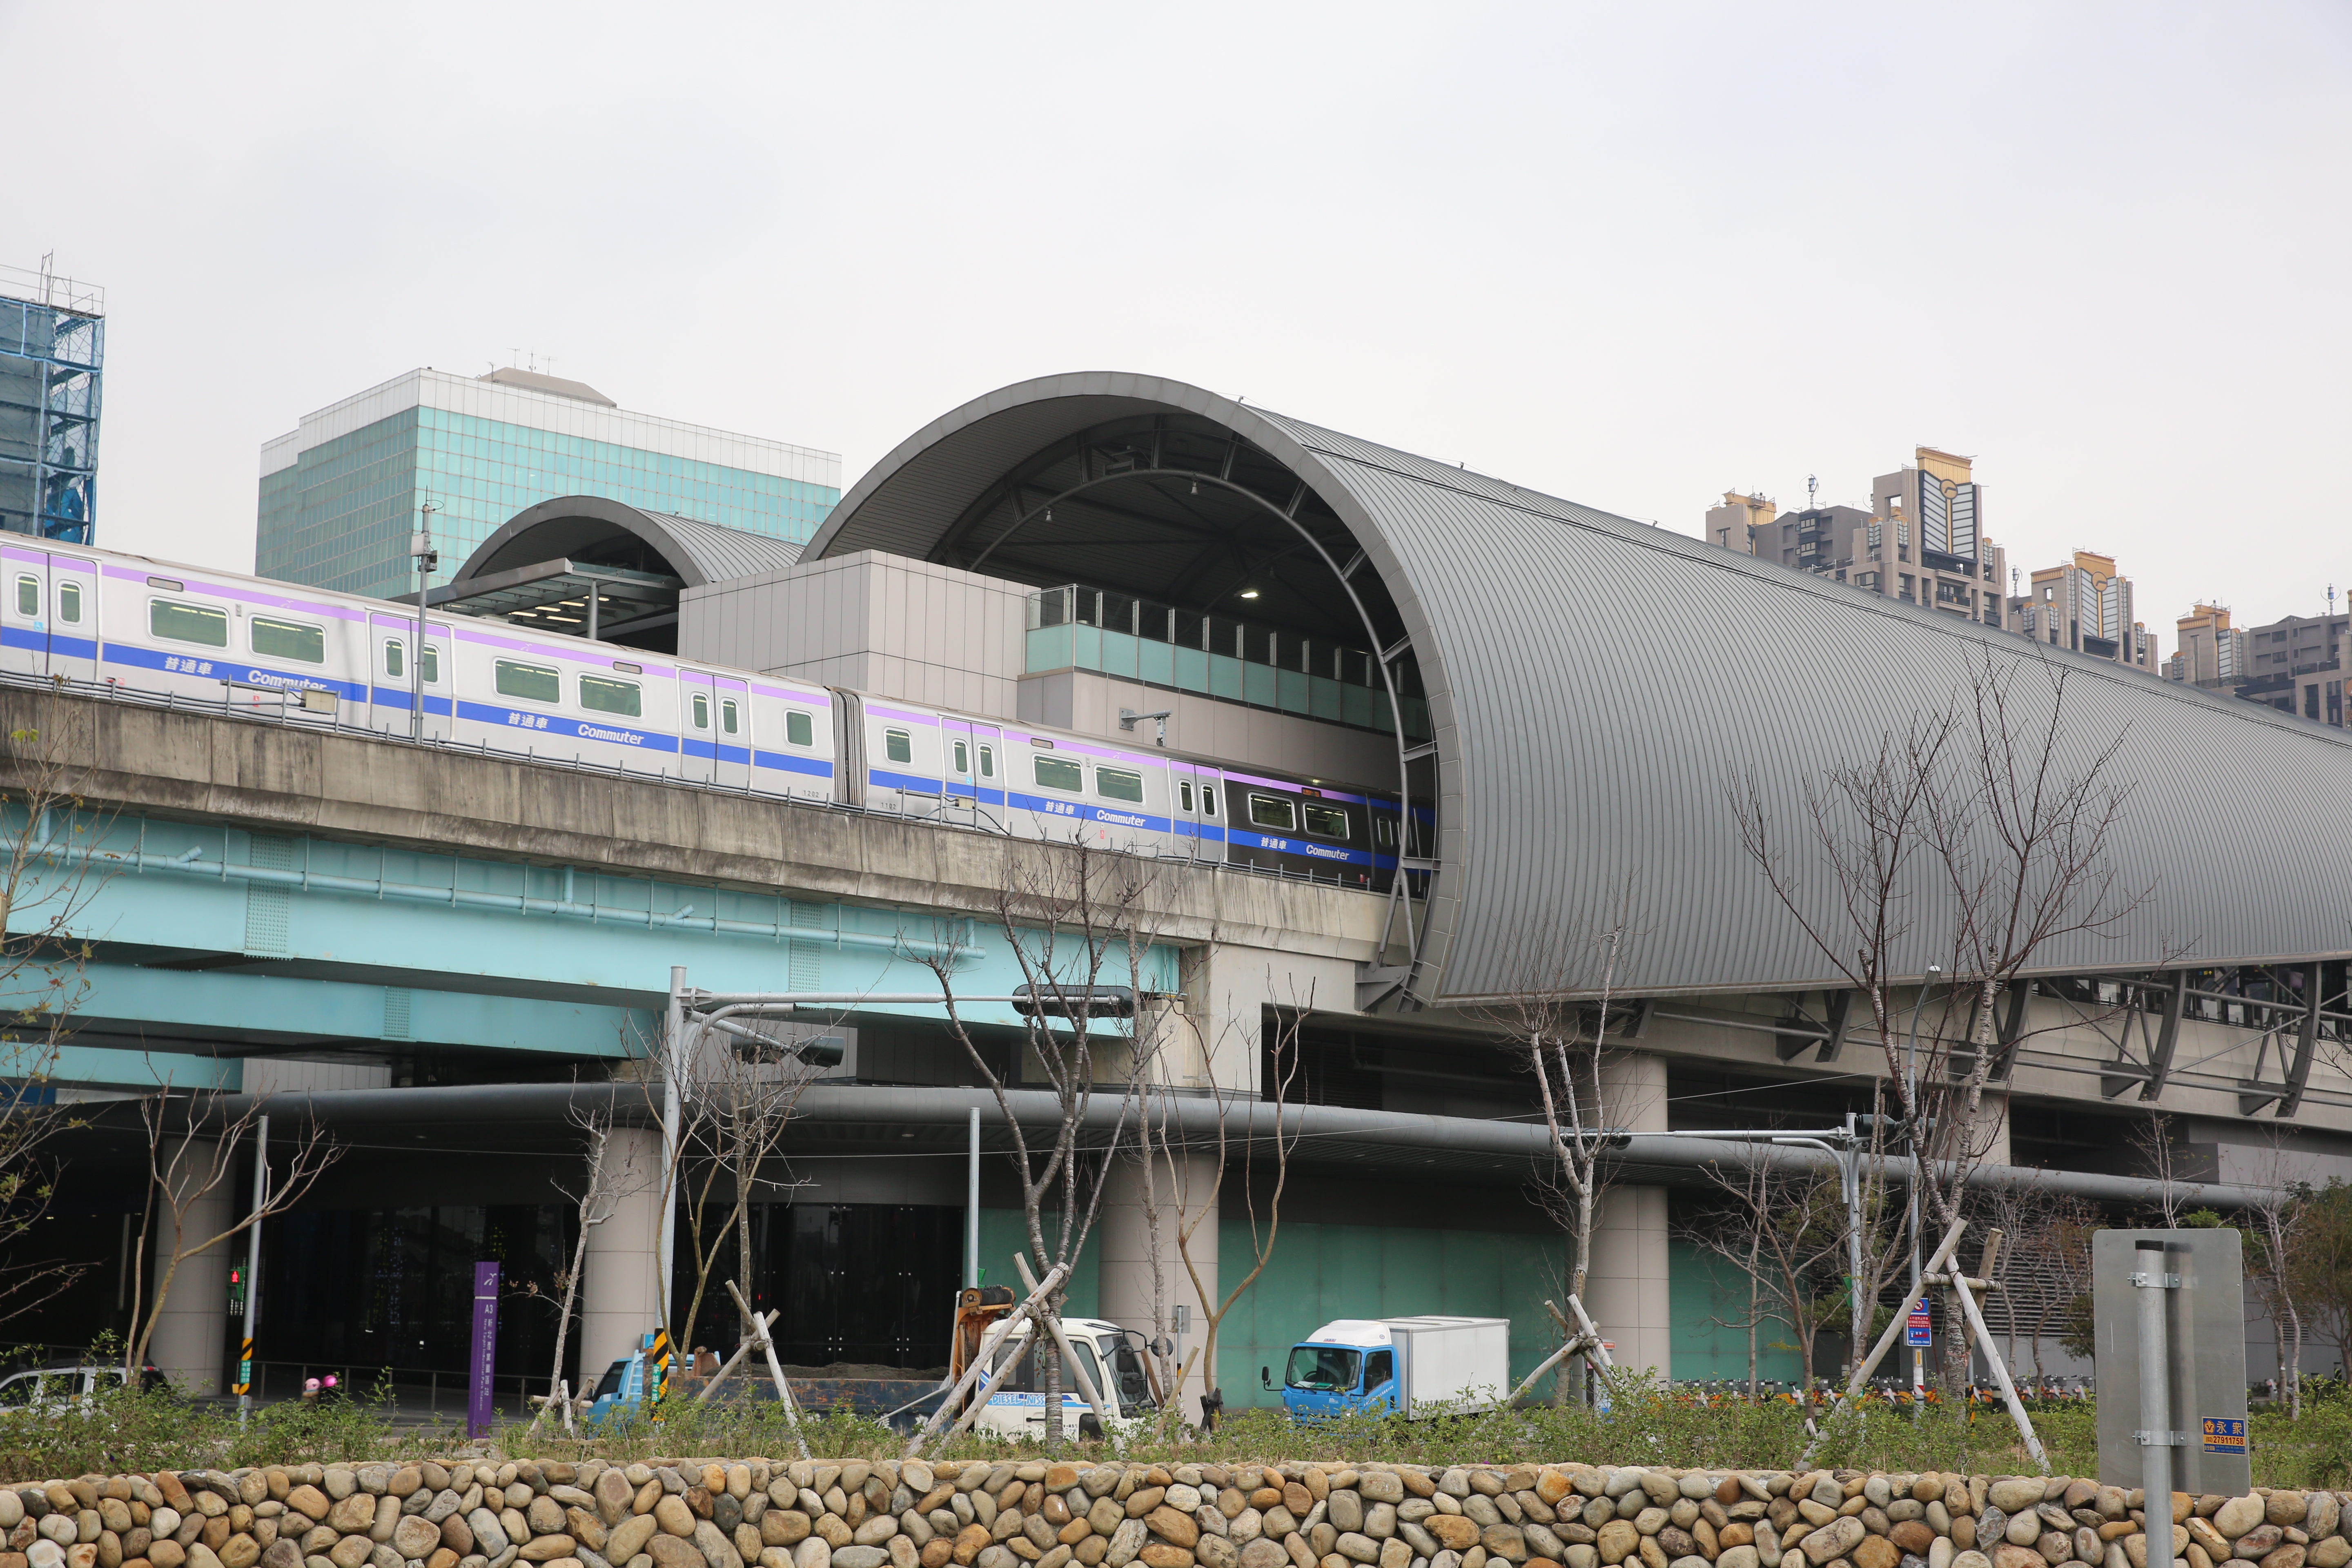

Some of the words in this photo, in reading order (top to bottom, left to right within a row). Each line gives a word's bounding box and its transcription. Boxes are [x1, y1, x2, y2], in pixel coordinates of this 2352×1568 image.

[164, 657, 213, 675] 普通車
[508, 712, 549, 729] 普通車
[578, 724, 644, 745] Commuter
[1045, 801, 1075, 815] 普通車
[1096, 809, 1146, 827] Commuter
[1261, 837, 1287, 850] 普通車
[1306, 844, 1349, 860] Commuter
[485, 1304, 493, 1314] A3
[992, 1394, 1022, 1405] DIESEL
[1026, 1394, 1045, 1405] NISS
